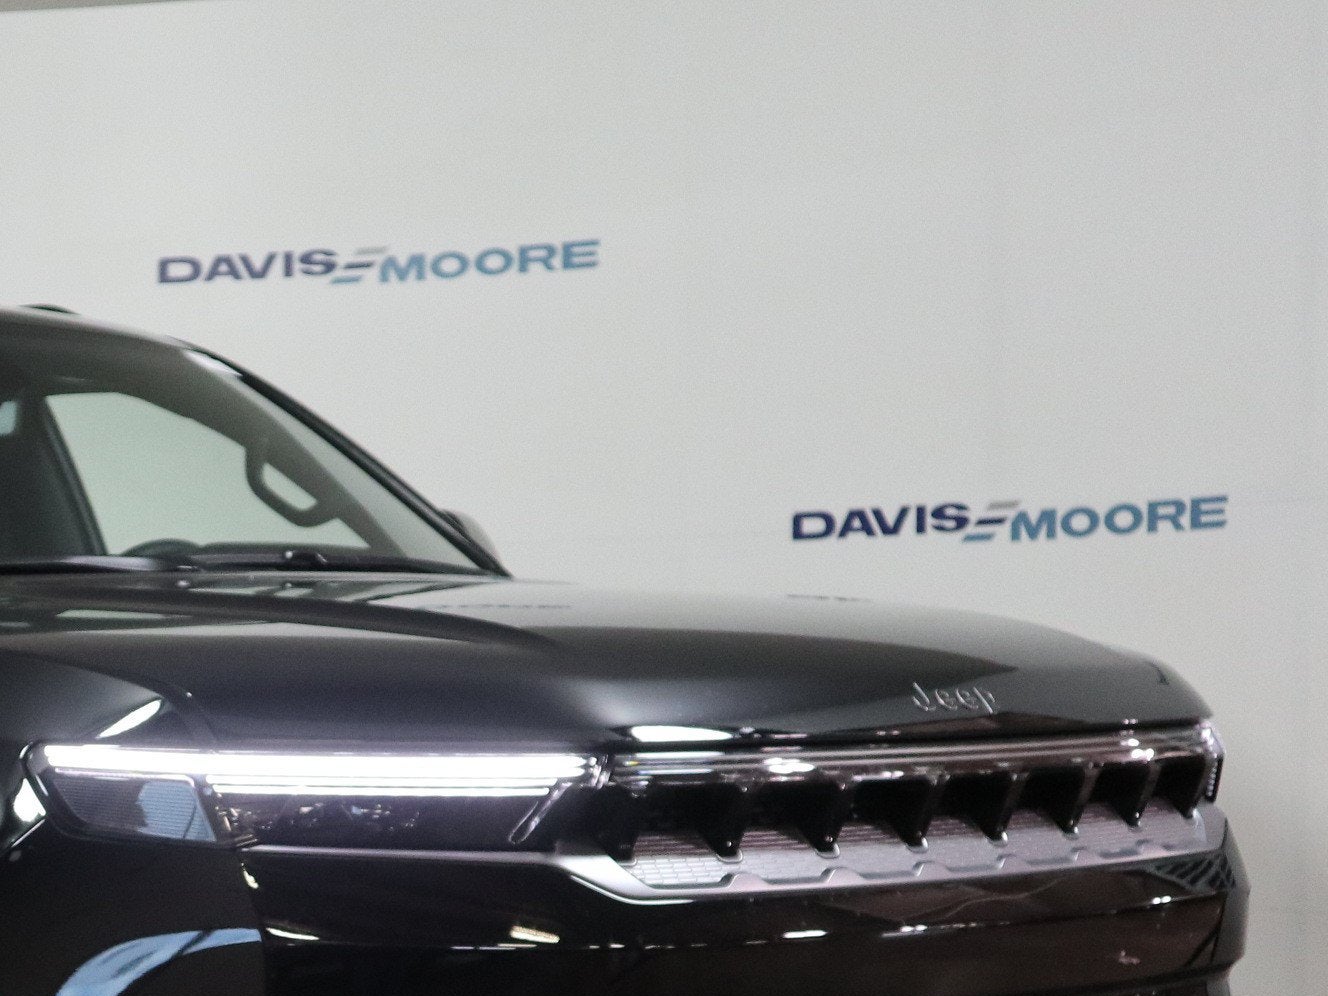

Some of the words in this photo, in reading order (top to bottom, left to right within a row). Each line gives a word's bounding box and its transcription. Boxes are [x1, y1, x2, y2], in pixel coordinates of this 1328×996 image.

[157, 248, 339, 284] DAVIS
[379, 239, 602, 283] MOORE
[791, 501, 970, 541] DAVIS
[1009, 495, 1230, 542] MOORE
[910, 681, 997, 715] Jeep
